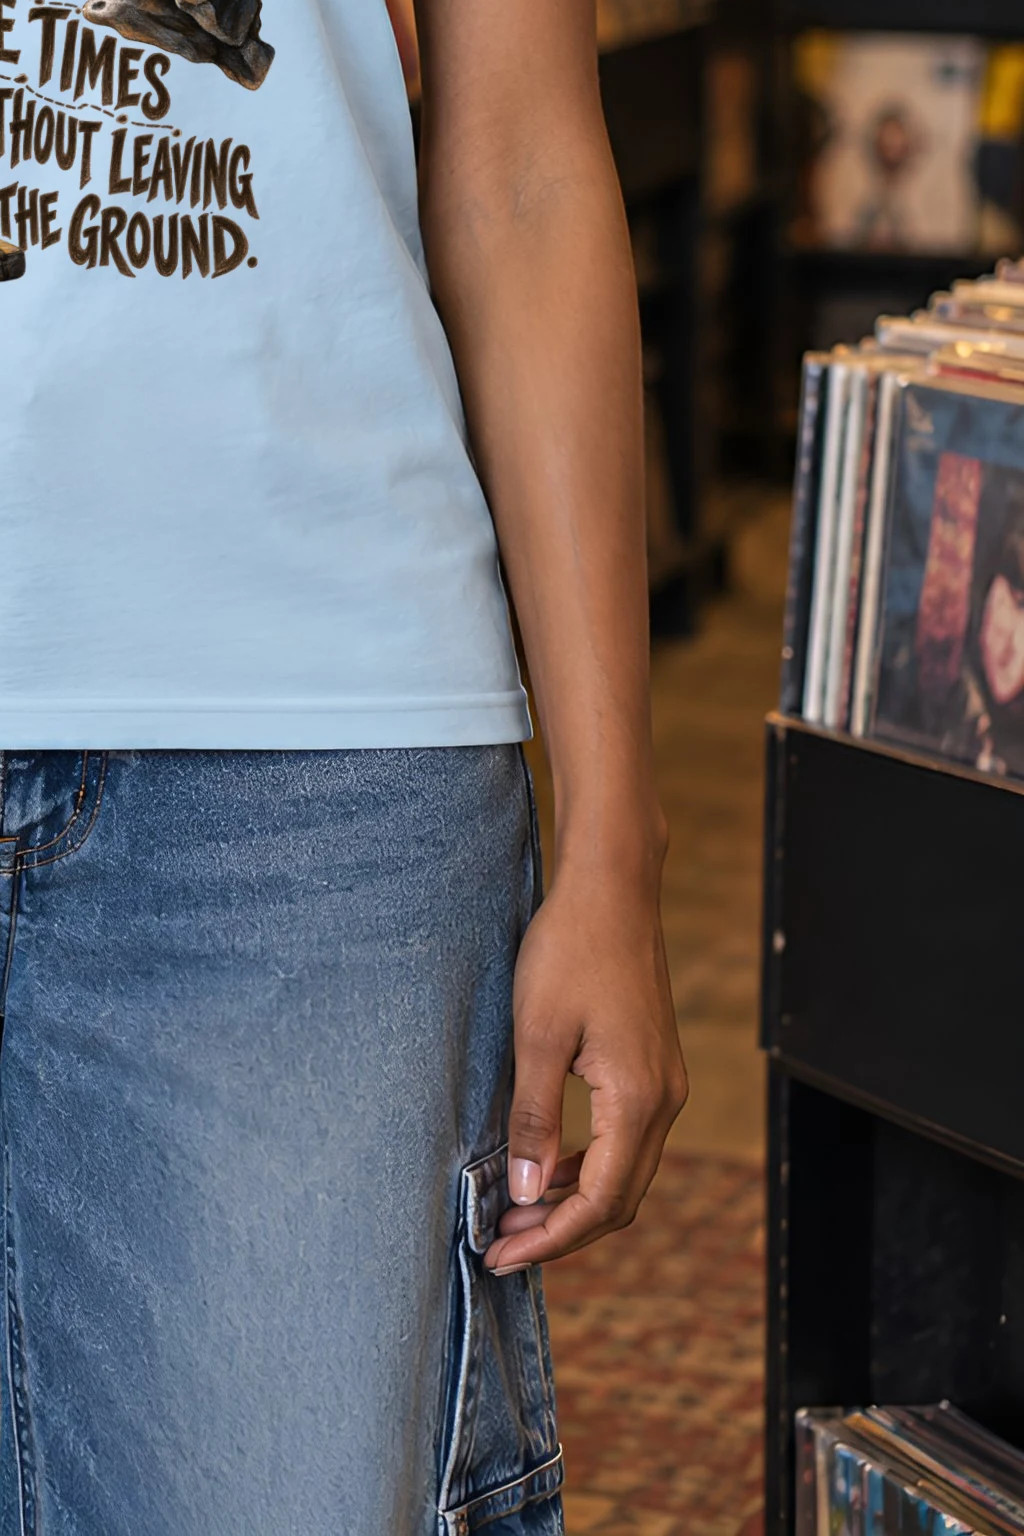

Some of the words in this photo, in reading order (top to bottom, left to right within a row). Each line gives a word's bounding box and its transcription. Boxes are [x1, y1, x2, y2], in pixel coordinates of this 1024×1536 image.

[28, 6, 171, 120] TIMES
[108, 128, 260, 220] LEAVING
[68, 193, 258, 280] GROUND.
